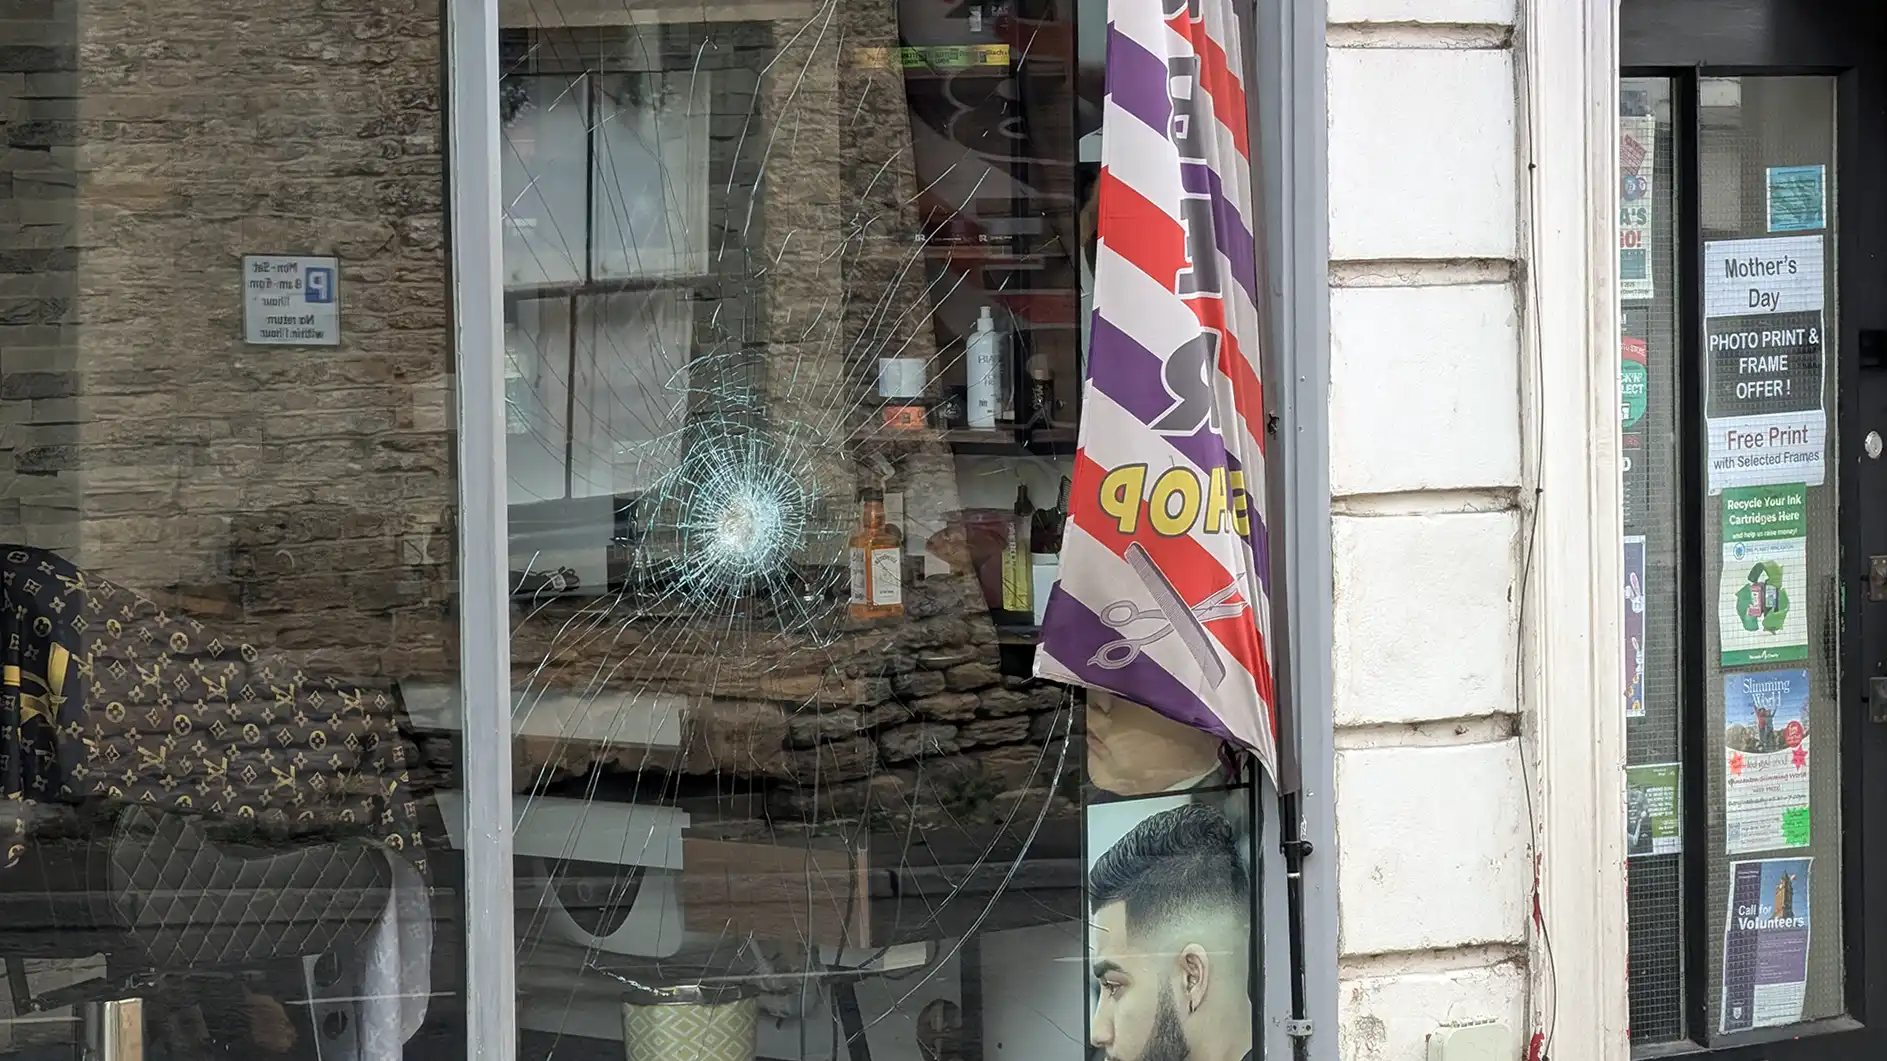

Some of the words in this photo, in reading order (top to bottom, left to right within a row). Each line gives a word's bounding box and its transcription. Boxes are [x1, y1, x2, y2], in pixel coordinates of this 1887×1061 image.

[1725, 255, 1797, 278] Mother's
[1748, 288, 1780, 312] Day
[1710, 332, 1758, 351] PHOTO
[1762, 329, 1805, 348] PRINT
[1808, 327, 1820, 344] &
[1739, 355, 1788, 374] FRAME
[1736, 380, 1783, 399] OFFER
[1727, 430, 1764, 451] Free
[1769, 424, 1809, 446] Print
[1714, 456, 1735, 470] with
[1737, 453, 1781, 468] Selected
[1783, 451, 1820, 464] Frames
[1727, 497, 1762, 511] Recycle
[1764, 496, 1785, 507] Your
[1787, 494, 1802, 505] Ink
[1729, 513, 1777, 526] Cartridges
[1778, 511, 1800, 521] Here
[1742, 677, 1791, 694] Slimming
[1751, 691, 1782, 707] World
[1738, 904, 1756, 916] Call
[1759, 903, 1772, 915] for
[1738, 916, 1805, 930] Volunteers
